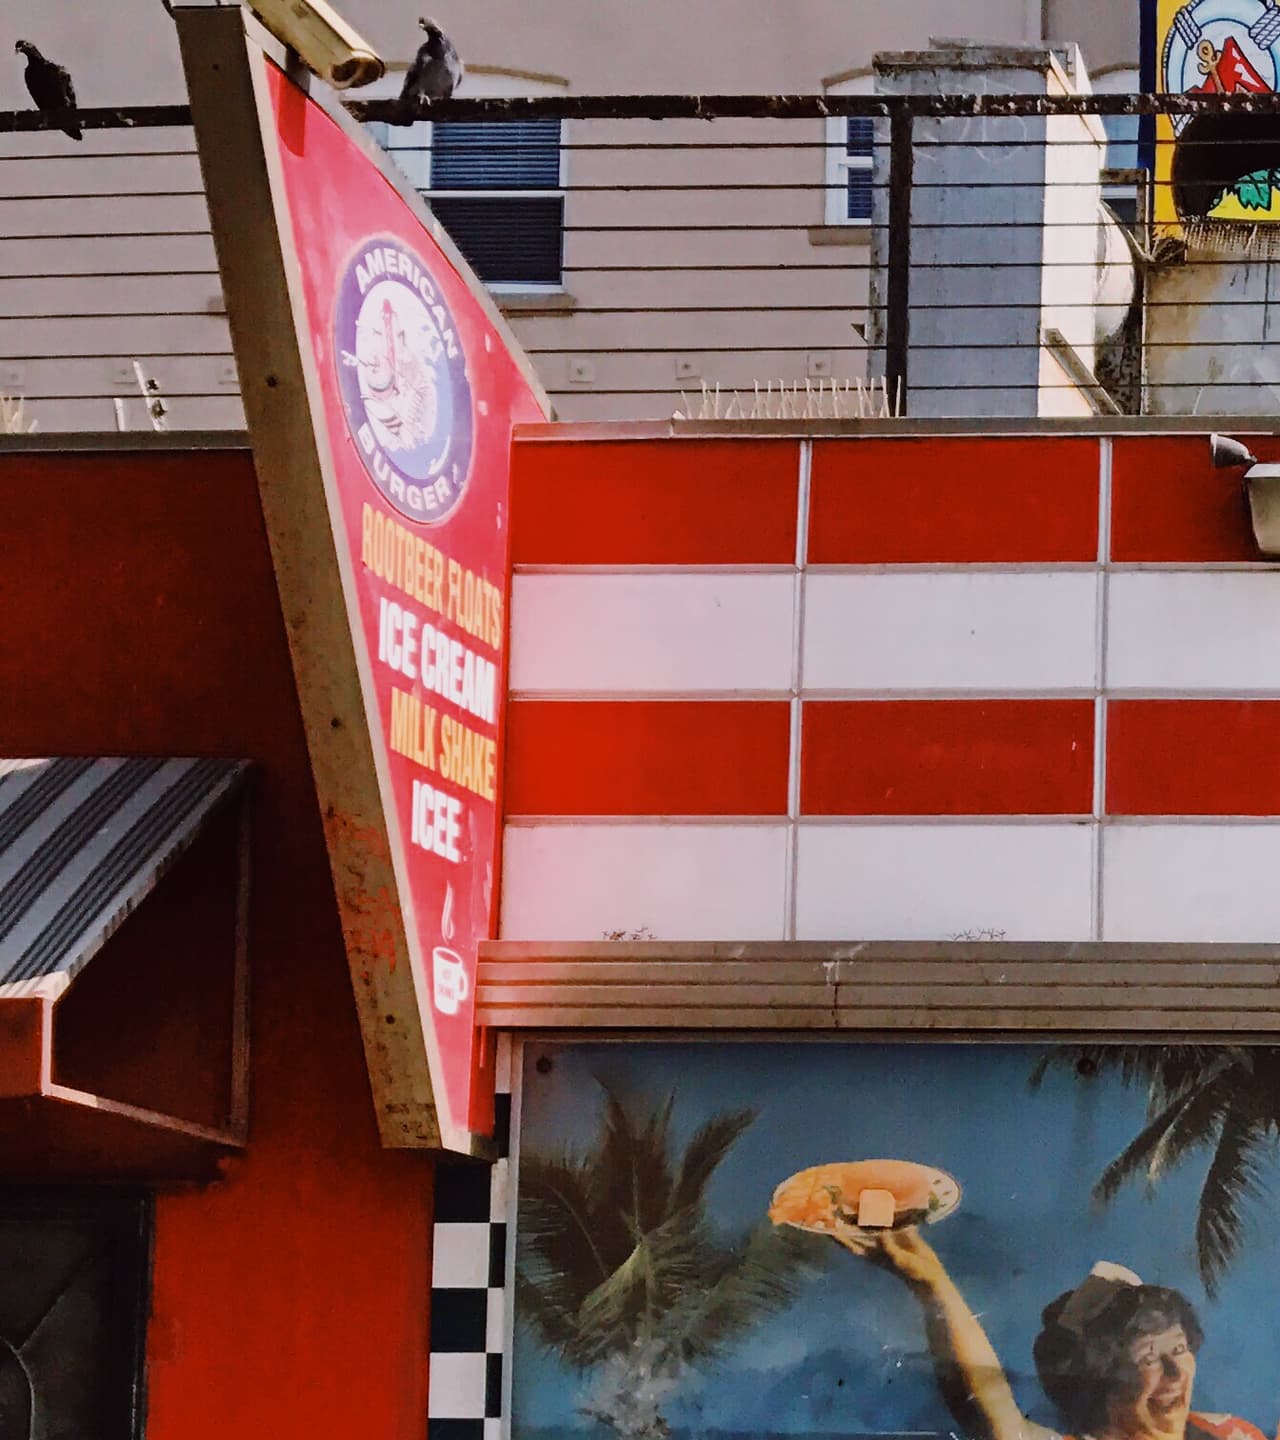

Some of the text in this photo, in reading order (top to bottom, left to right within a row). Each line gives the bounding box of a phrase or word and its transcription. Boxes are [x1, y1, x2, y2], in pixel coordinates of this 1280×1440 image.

[355, 247, 459, 360] AMERICAN
[356, 421, 452, 511] BURGER
[378, 596, 497, 725] ICE CREAM
[447, 557, 502, 651] FLOATS
[389, 685, 497, 803] MILK SHAKE
